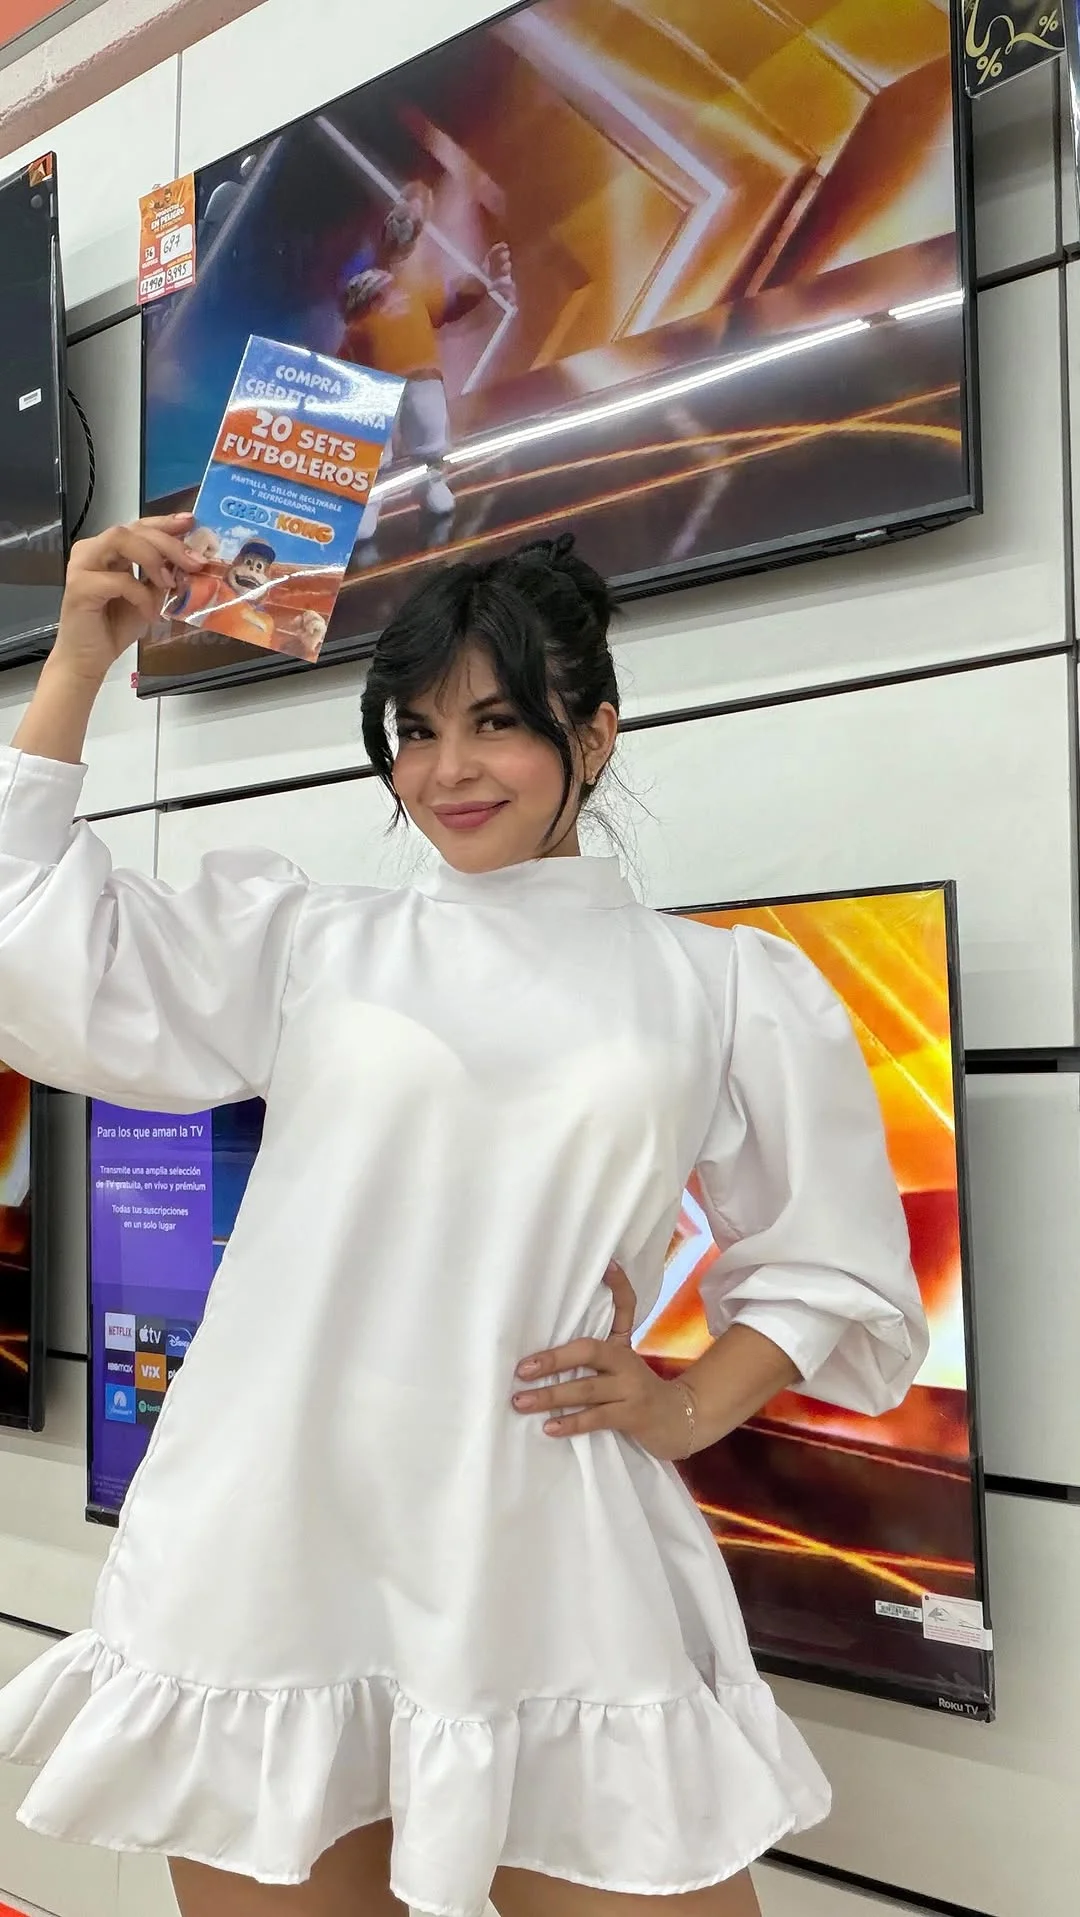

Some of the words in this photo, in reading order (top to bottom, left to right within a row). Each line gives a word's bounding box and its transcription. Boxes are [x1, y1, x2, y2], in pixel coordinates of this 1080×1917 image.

[161, 207, 185, 226] PELIGRO
[275, 365, 342, 396] COMPRA
[251, 408, 293, 442] 20
[297, 429, 357, 461] SETS
[222, 432, 370, 492] FUTBOLEROS
[251, 488, 257, 496] Y
[257, 490, 316, 514] REFRIGERADORA
[299, 493, 343, 512] RECLINABLE
[97, 1126, 116, 1138] Para
[118, 1126, 131, 1138] los
[133, 1128, 150, 1139] que
[152, 1128, 177, 1138] aman
[179, 1126, 188, 1137] la
[190, 1126, 203, 1137] TV
[100, 1166, 131, 1175] Transmite
[132, 1167, 144, 1175] una
[145, 1167, 168, 1176] amplia
[169, 1167, 201, 1176] selección
[96, 1181, 104, 1189] de
[105, 1181, 115, 1189] TV
[153, 1182, 168, 1191] vivo
[175, 1182, 206, 1192] prémium
[112, 1204, 131, 1214] Todas
[132, 1206, 142, 1215] tus
[143, 1205, 189, 1217] suscripciones
[133, 1221, 142, 1229] un
[143, 1220, 157, 1230] solo
[158, 1220, 176, 1231] lugar
[108, 1325, 132, 1337] NETFLIX
[964, 1703, 979, 1715] TV
